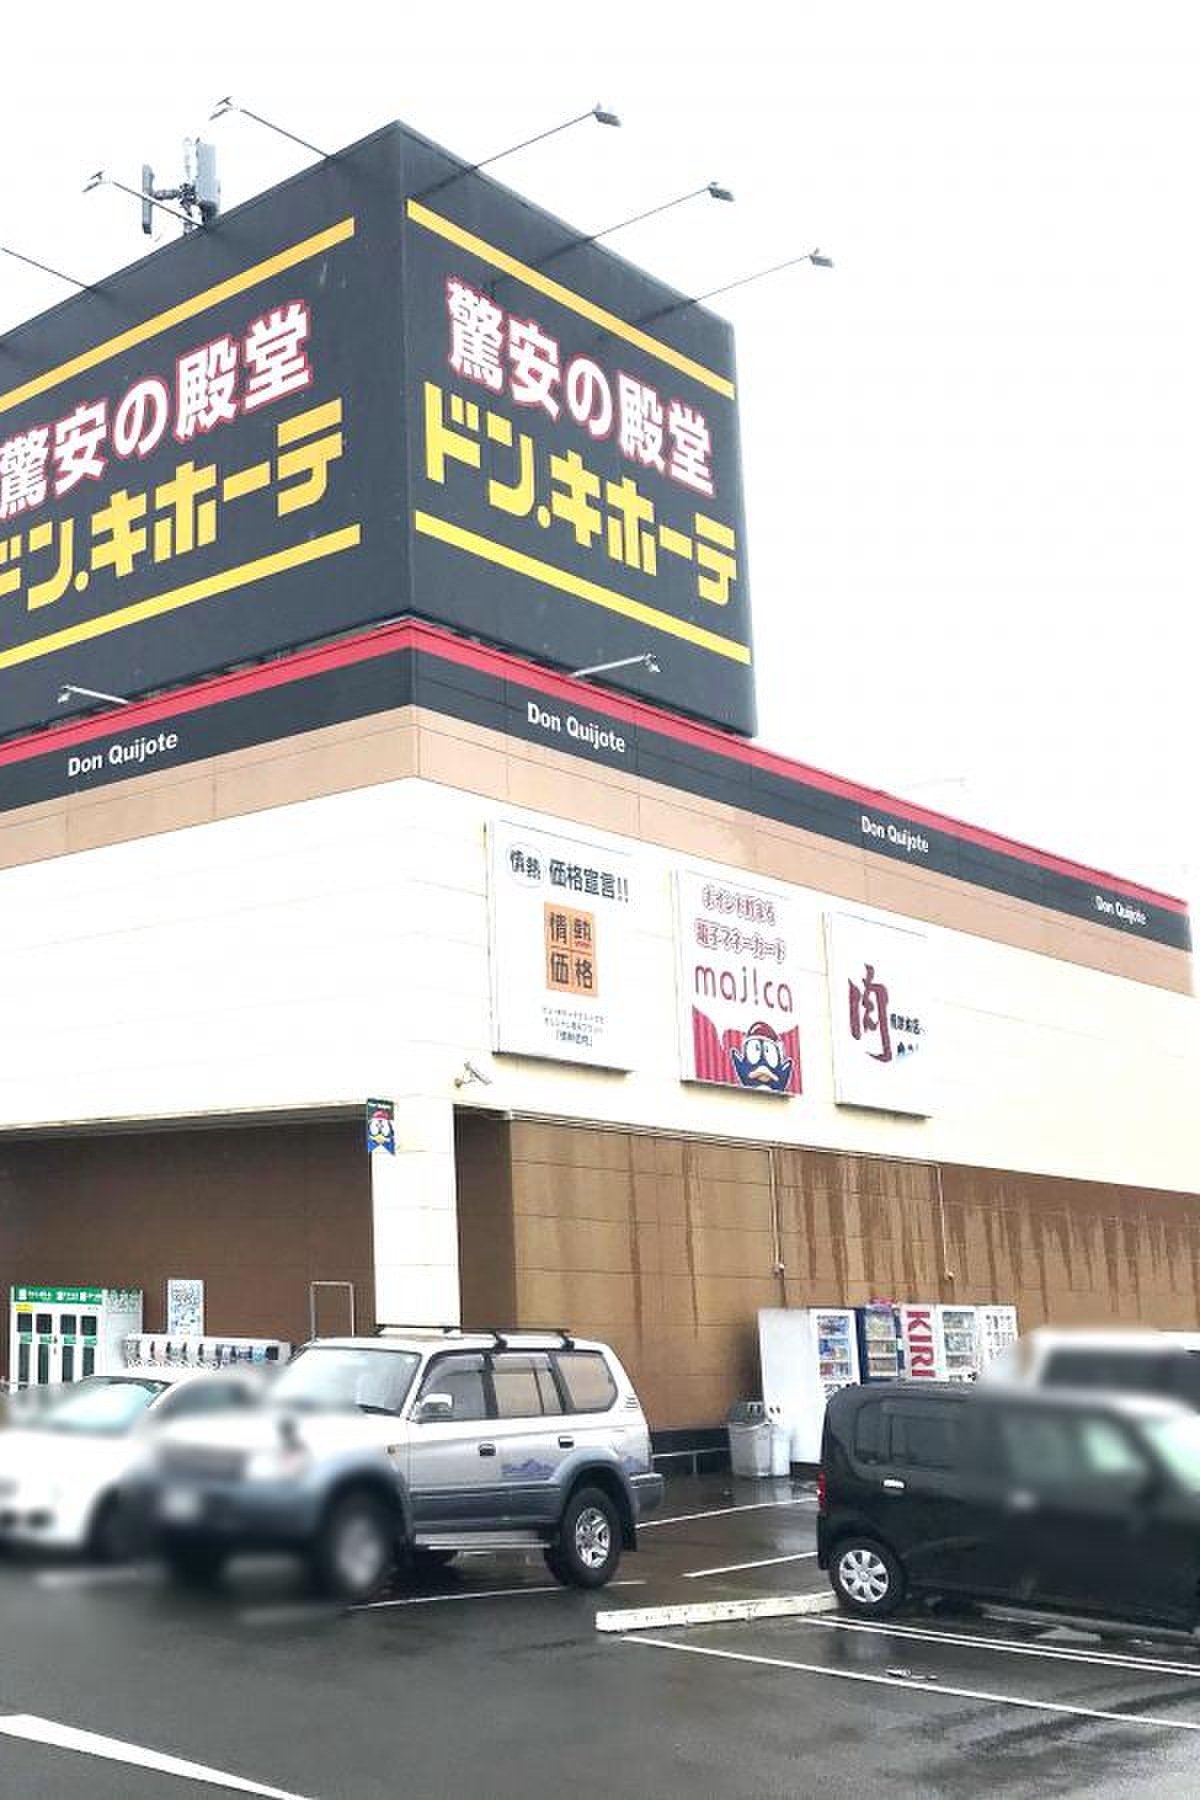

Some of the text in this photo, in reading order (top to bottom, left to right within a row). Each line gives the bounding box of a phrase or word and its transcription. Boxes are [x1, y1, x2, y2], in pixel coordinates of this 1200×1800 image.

[446, 273, 716, 498] 驚安の殿堂
[527, 701, 626, 753] Don Quijote
[67, 732, 179, 777] Don Quijote
[861, 815, 885, 838] Don
[847, 961, 893, 1064] 肉
